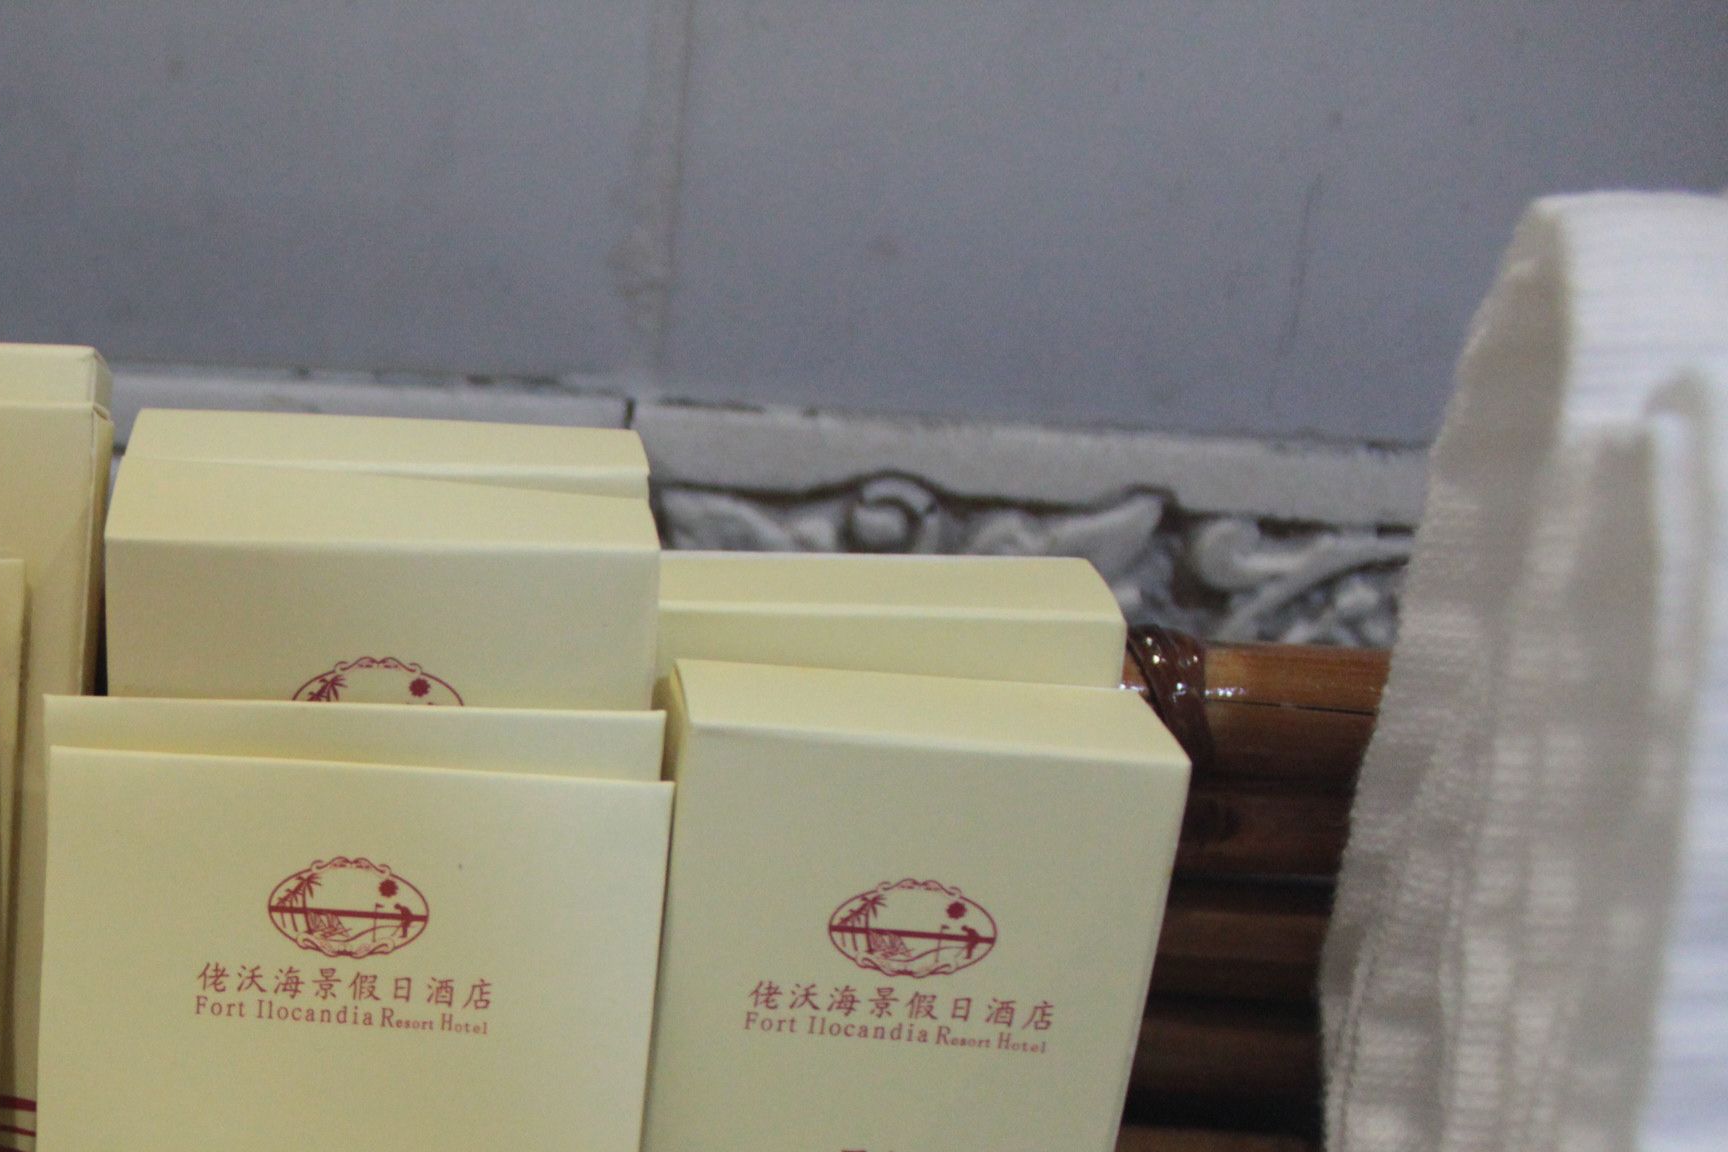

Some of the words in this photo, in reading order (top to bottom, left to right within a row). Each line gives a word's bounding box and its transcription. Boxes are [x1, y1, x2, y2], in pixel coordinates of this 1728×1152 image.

[196, 962, 493, 1011] 佬沃海景假日酒店
[748, 980, 1055, 1031] 佬沃海景假日酒店
[195, 995, 246, 1018] Fort
[256, 999, 374, 1027] Ilocandia
[380, 1007, 434, 1031] Resort
[440, 1013, 489, 1035] Hotel
[744, 1011, 796, 1034] Fort
[807, 1014, 929, 1043] Ilocandia
[935, 1025, 991, 1049] Resort
[997, 1032, 1048, 1054] Hotel
